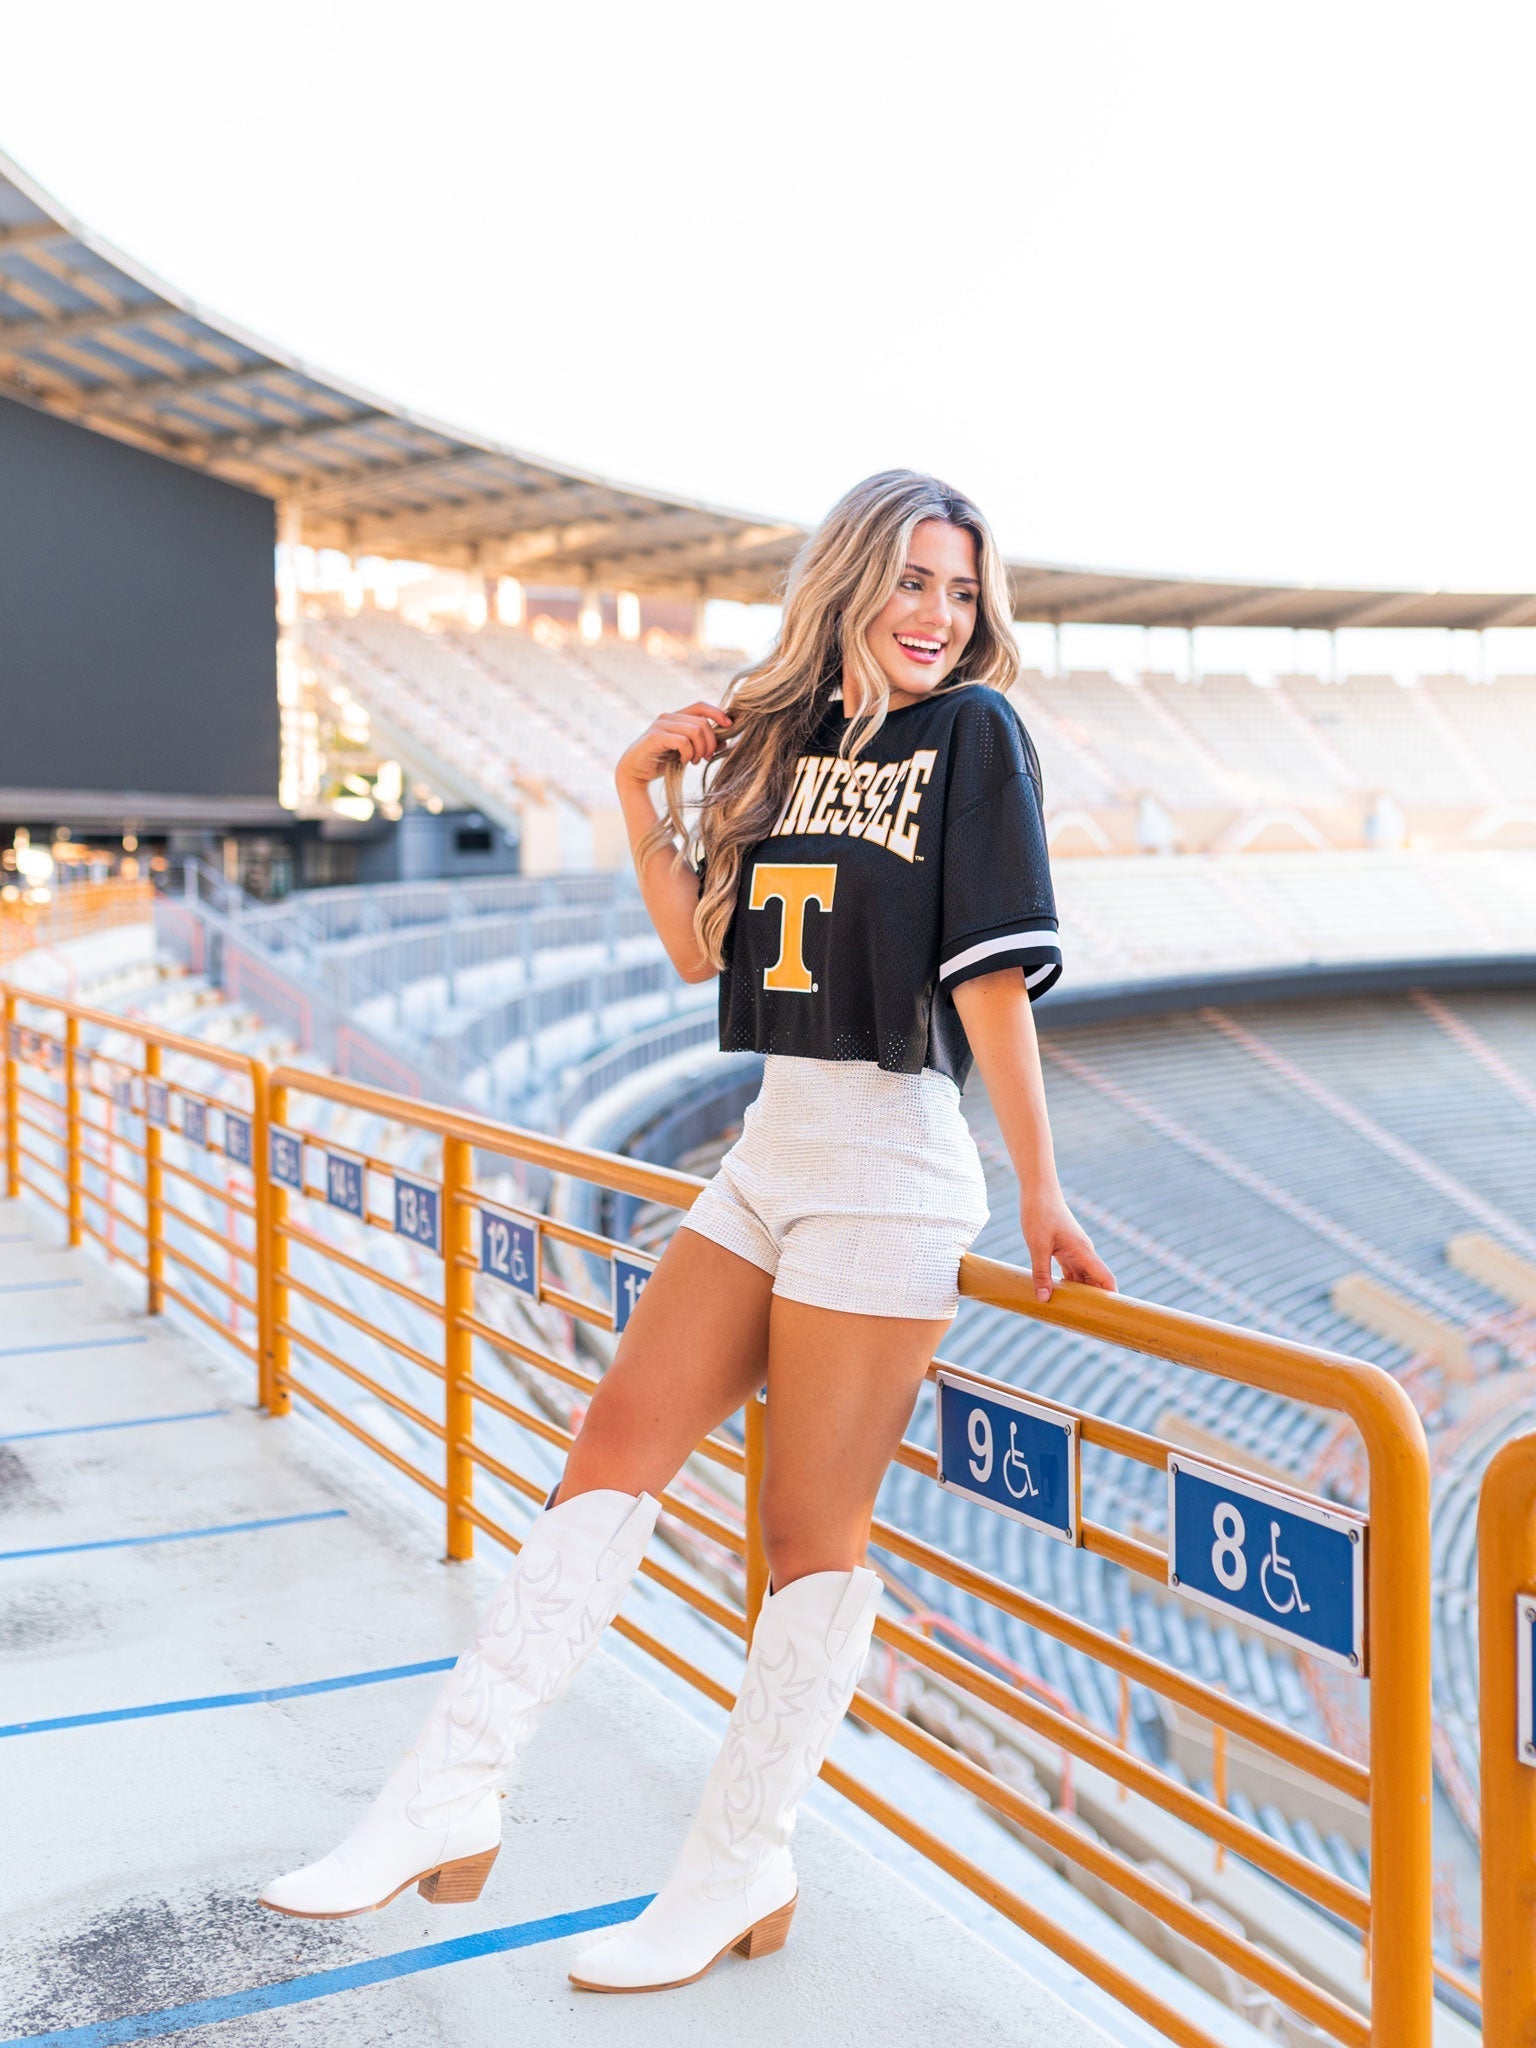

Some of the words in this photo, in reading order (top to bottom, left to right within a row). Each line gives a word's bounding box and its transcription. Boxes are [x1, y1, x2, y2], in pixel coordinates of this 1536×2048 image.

[749, 863, 837, 993] T
[330, 1161, 347, 1206] 14
[398, 1185, 418, 1234] 13
[487, 1221, 509, 1275] 12
[624, 1273, 649, 1317] 1
[967, 1408, 994, 1483] 9
[1211, 1501, 1248, 1593] 8
